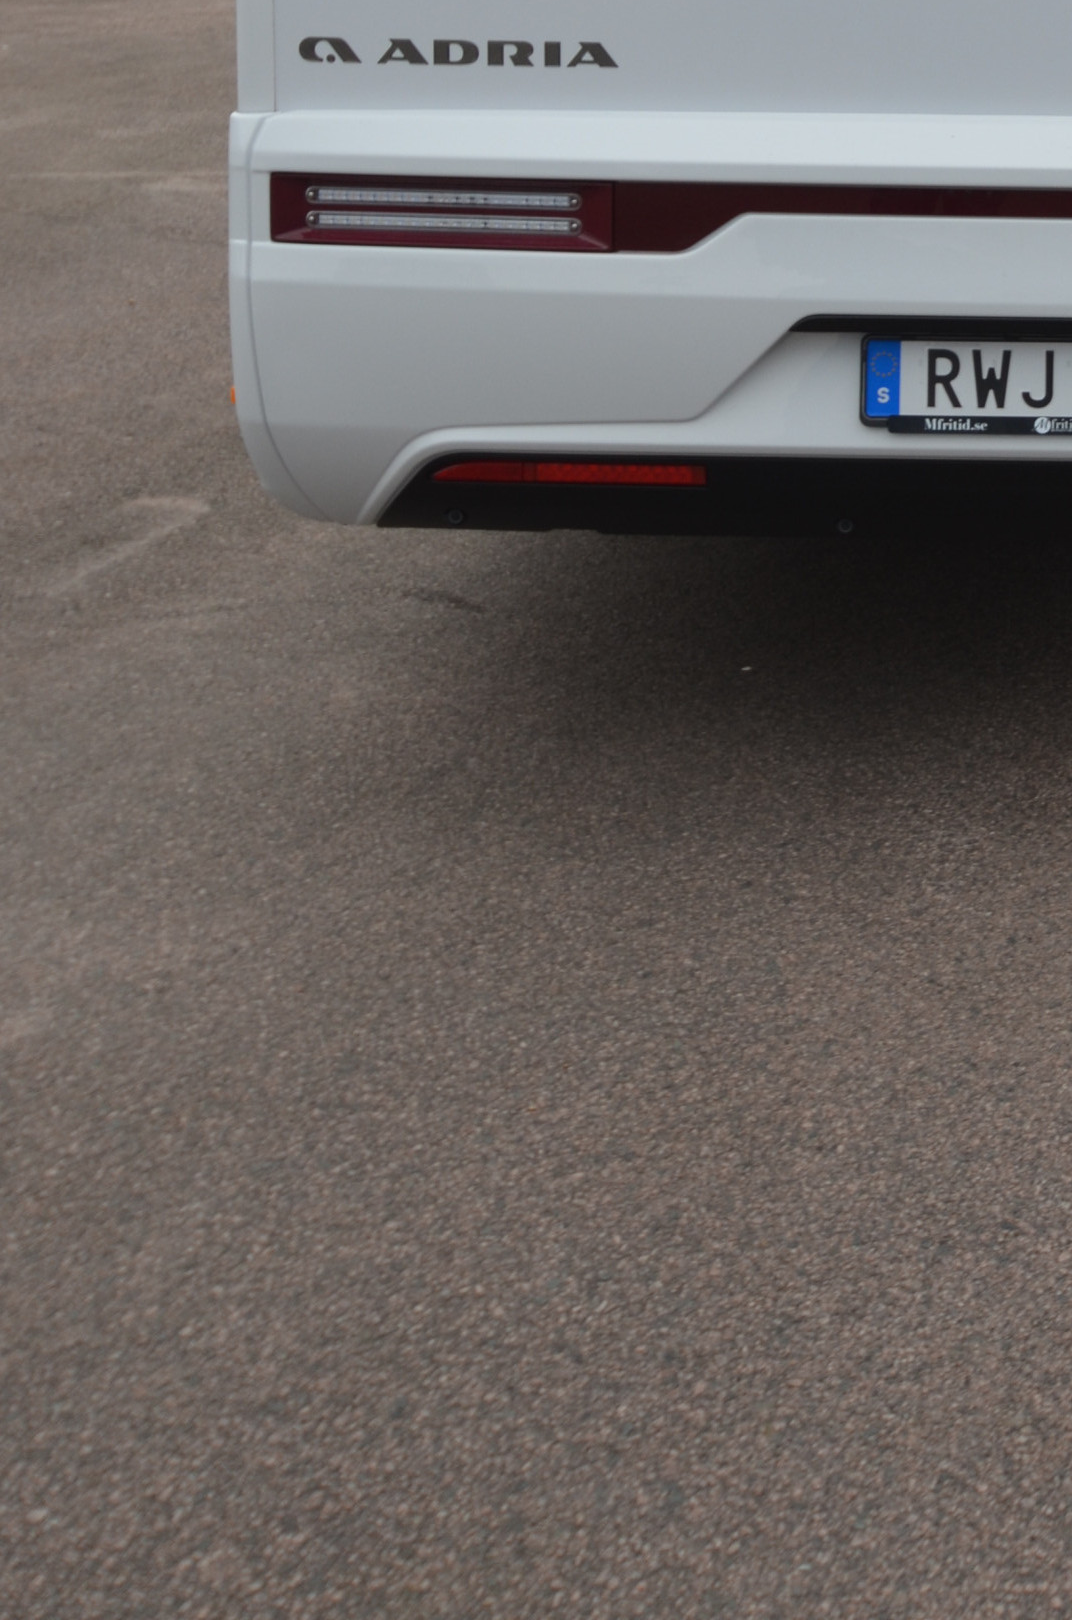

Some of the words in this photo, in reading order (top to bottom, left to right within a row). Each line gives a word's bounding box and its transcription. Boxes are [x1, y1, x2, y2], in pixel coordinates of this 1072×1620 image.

[377, 38, 619, 68] ADRIA
[926, 348, 1054, 409] RWJ
[877, 387, 890, 404] S
[924, 418, 988, 431] Mfritid.se
